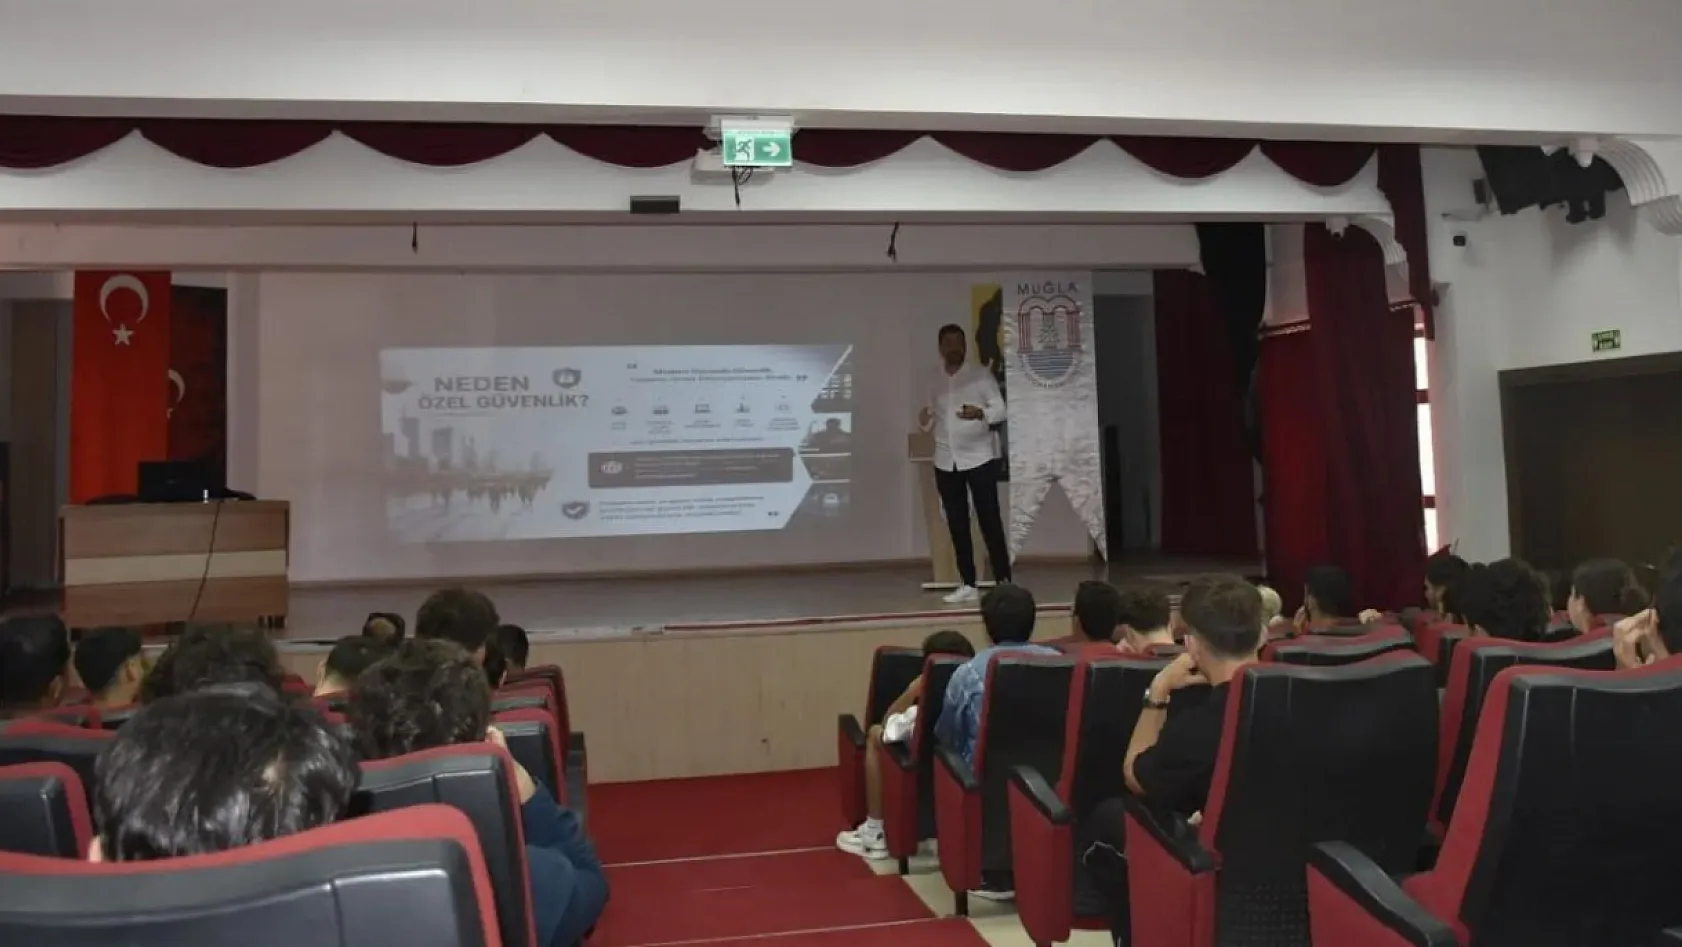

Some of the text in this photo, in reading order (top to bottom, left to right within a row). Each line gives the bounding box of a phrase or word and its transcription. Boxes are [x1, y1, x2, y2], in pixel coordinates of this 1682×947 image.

[1017, 280, 1078, 296] MUĞLA
[434, 376, 530, 393] NEDEN
[418, 393, 590, 410] ÖZEL GÜVENLİK?
